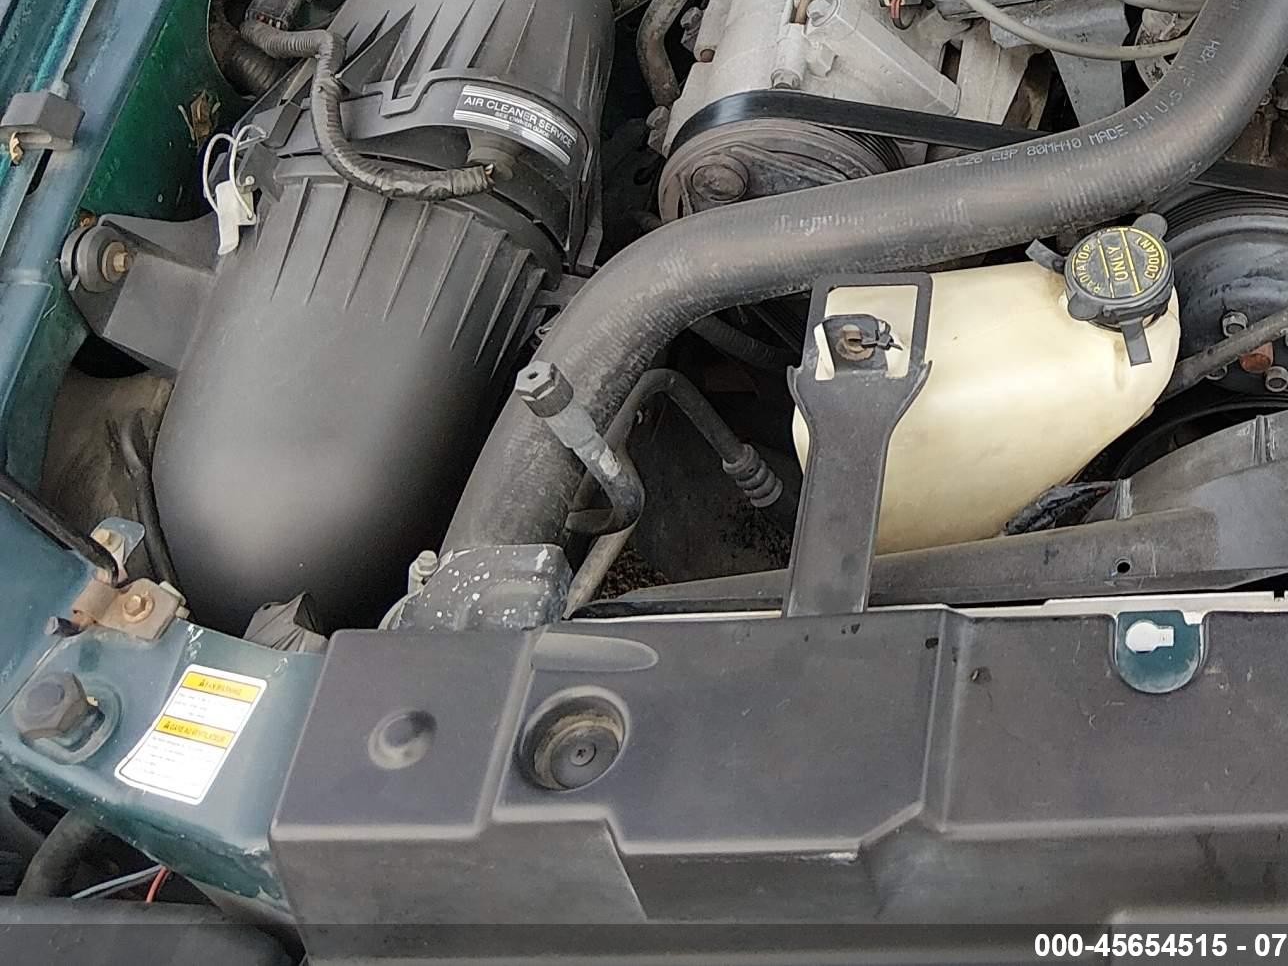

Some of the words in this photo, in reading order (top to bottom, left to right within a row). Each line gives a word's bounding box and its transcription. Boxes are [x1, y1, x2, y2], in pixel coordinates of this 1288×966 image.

[463, 98, 484, 107] AIR
[486, 100, 538, 123] CLEANER
[536, 118, 573, 148] SERVICE
[1089, 125, 1129, 146] MADE
[1106, 245, 1129, 281] ONLY
